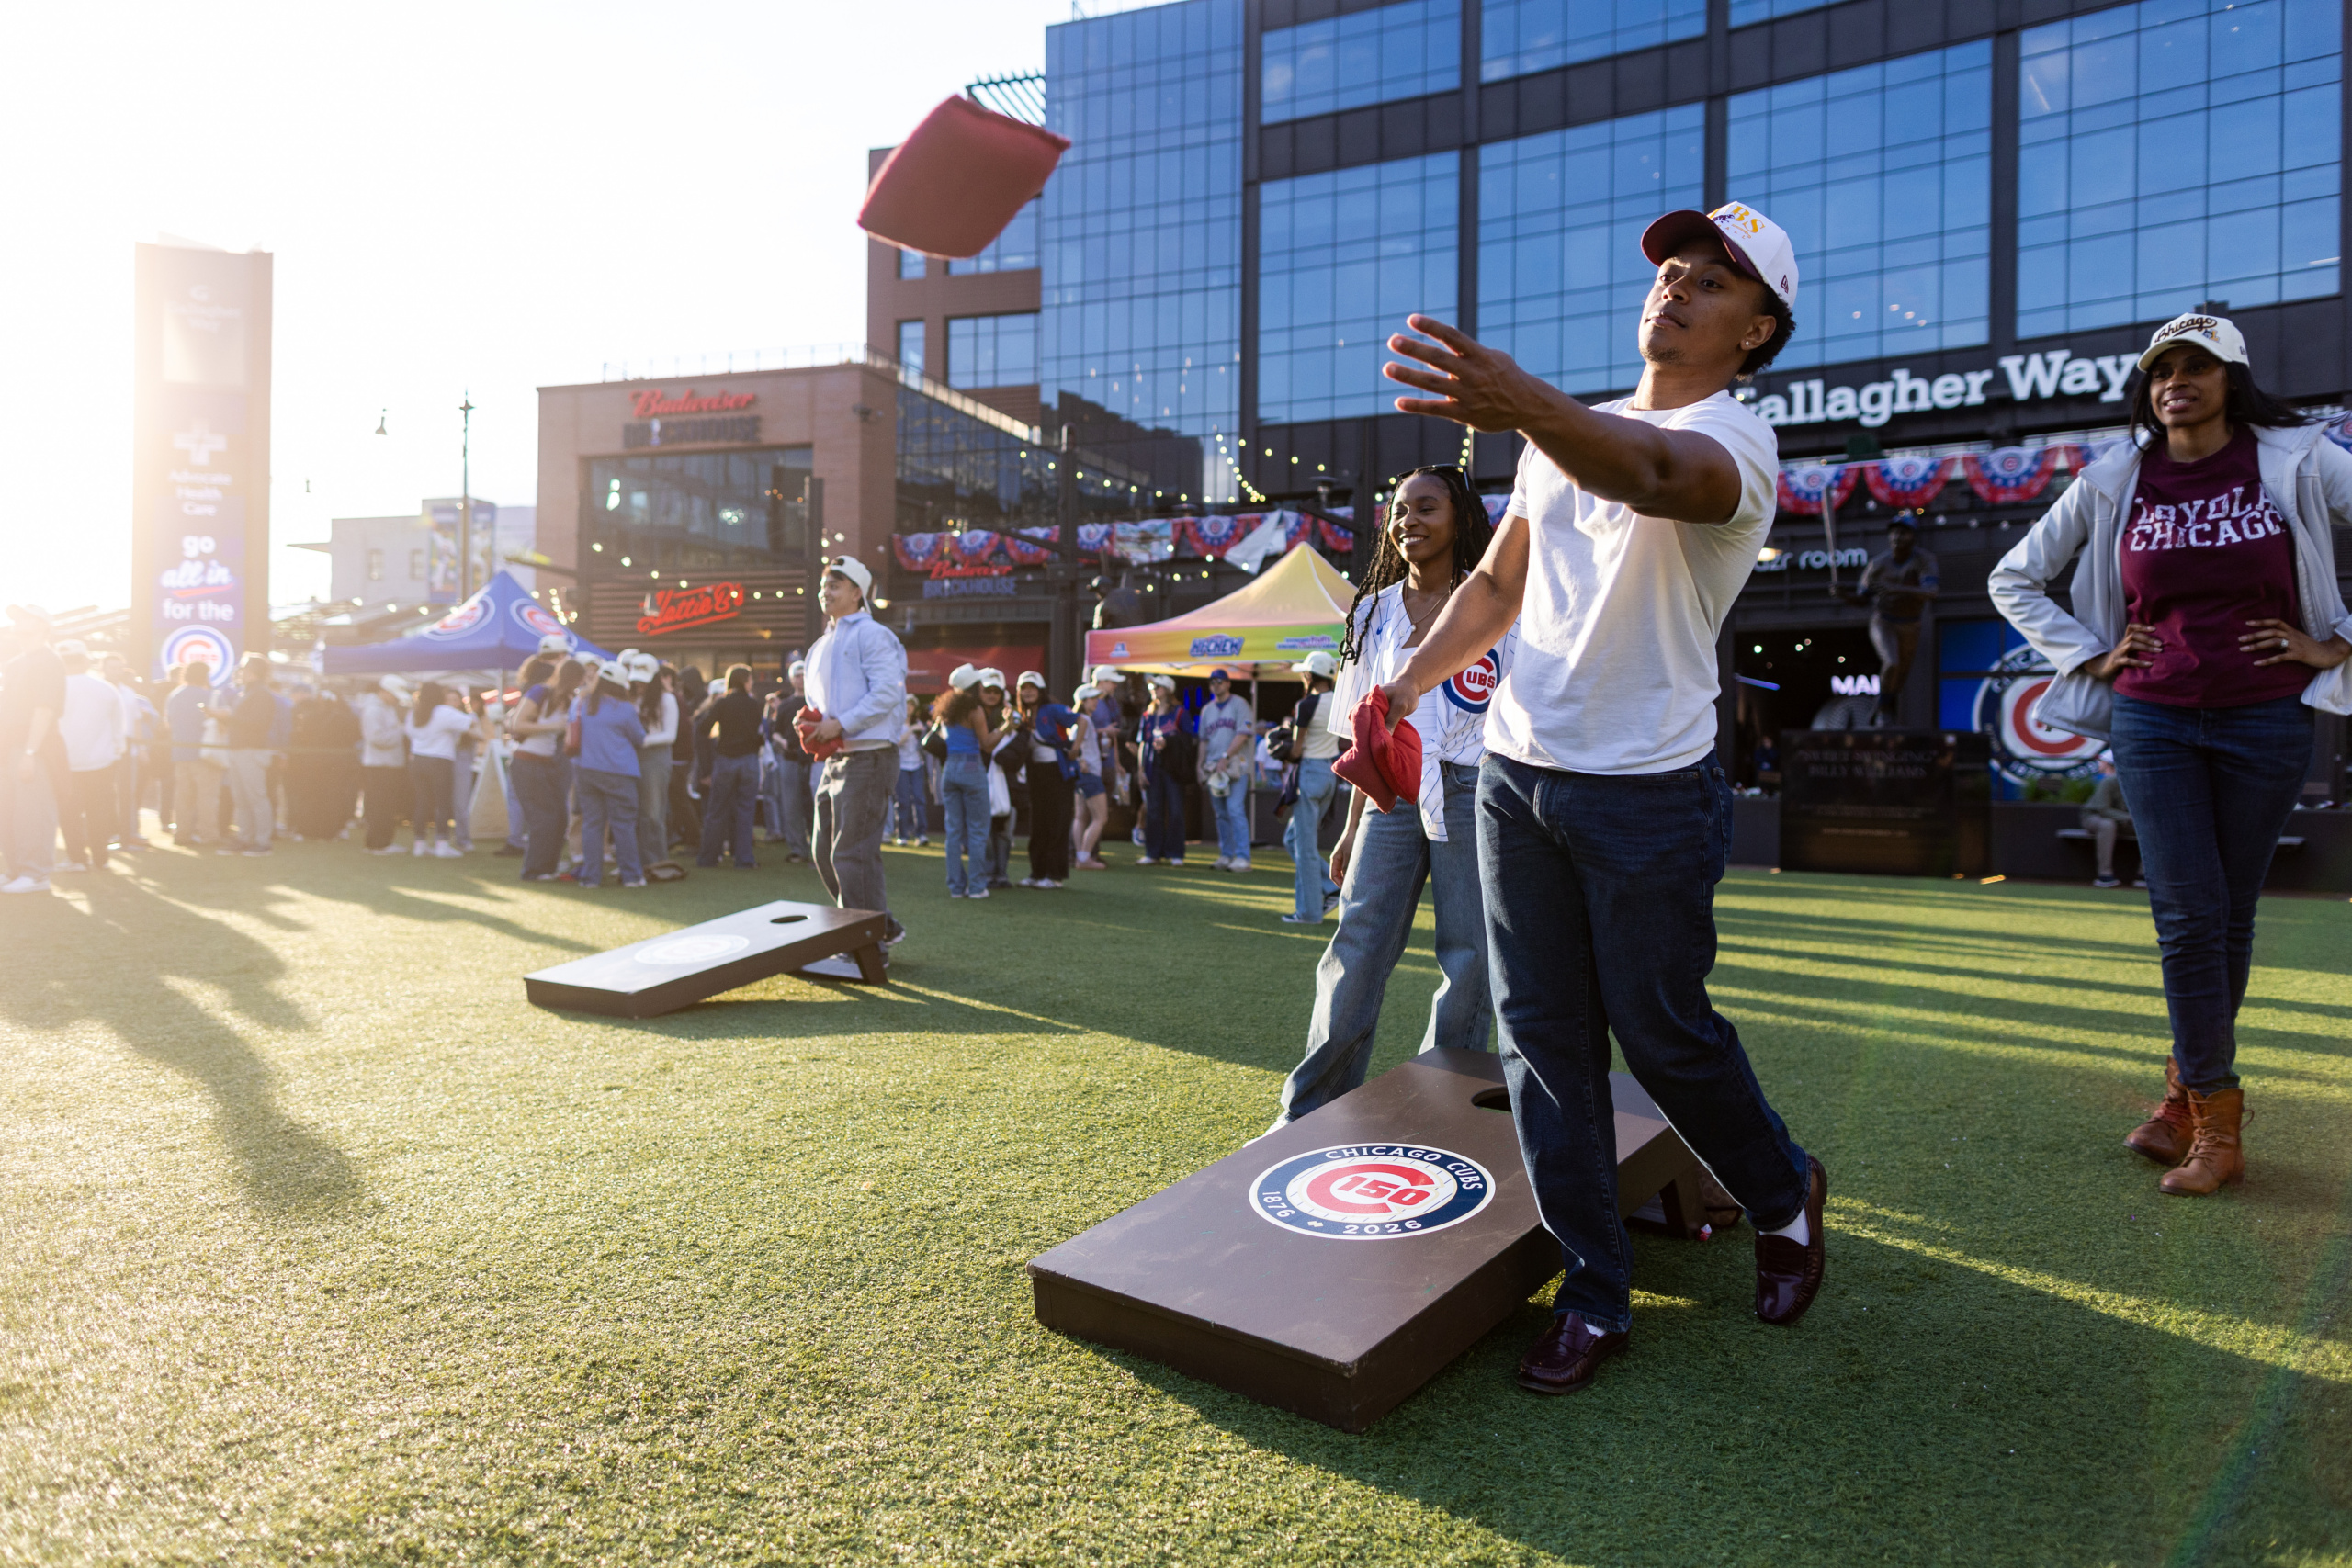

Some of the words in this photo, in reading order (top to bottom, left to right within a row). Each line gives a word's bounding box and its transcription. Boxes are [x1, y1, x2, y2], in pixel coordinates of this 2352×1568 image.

[2154, 317, 2217, 343] Chicago
[1999, 349, 2141, 403] Way
[629, 389, 755, 417] Budweiser
[2133, 482, 2276, 527] LOYOLA
[2130, 510, 2285, 551] CHICAGO
[182, 535, 216, 558] go
[1799, 547, 1868, 570] room
[161, 560, 205, 587] all
[206, 560, 232, 585] in
[929, 560, 1012, 580] Budweiser
[162, 598, 195, 620] for
[198, 600, 235, 622] the
[1453, 657, 1496, 702] CUBS
[1325, 1146, 1442, 1162] CHICAGO
[1446, 1161, 1483, 1190] CUBS
[1338, 1176, 1430, 1205] 150
[1261, 1191, 1296, 1219] 1876
[1342, 1220, 1422, 1235] 2026
